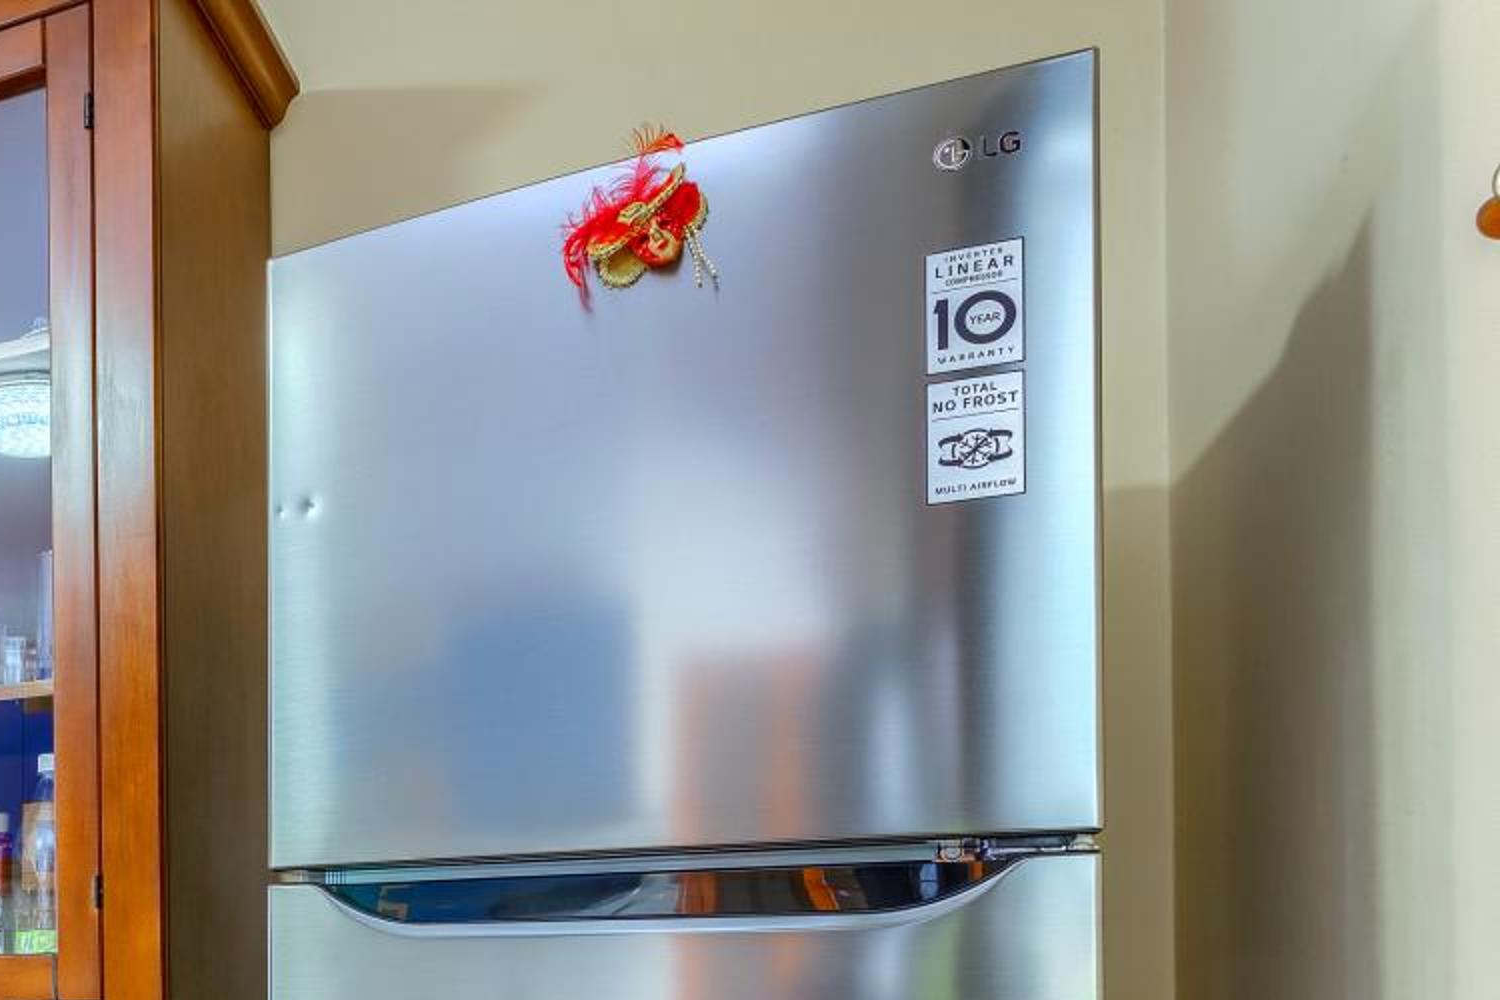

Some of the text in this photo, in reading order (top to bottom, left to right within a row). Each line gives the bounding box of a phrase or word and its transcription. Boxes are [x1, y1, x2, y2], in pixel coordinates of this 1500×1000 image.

[982, 131, 1021, 157] LG
[945, 247, 1003, 262] INVERTER
[935, 255, 1014, 279] LINEAR
[933, 290, 1017, 351] 10
[969, 311, 1002, 325] YEAR
[937, 346, 1014, 364] WARRANTY
[952, 381, 998, 396] TOTAL
[933, 390, 1019, 413] NO FROST
[935, 477, 1017, 495] MULTI AIRFLOW
